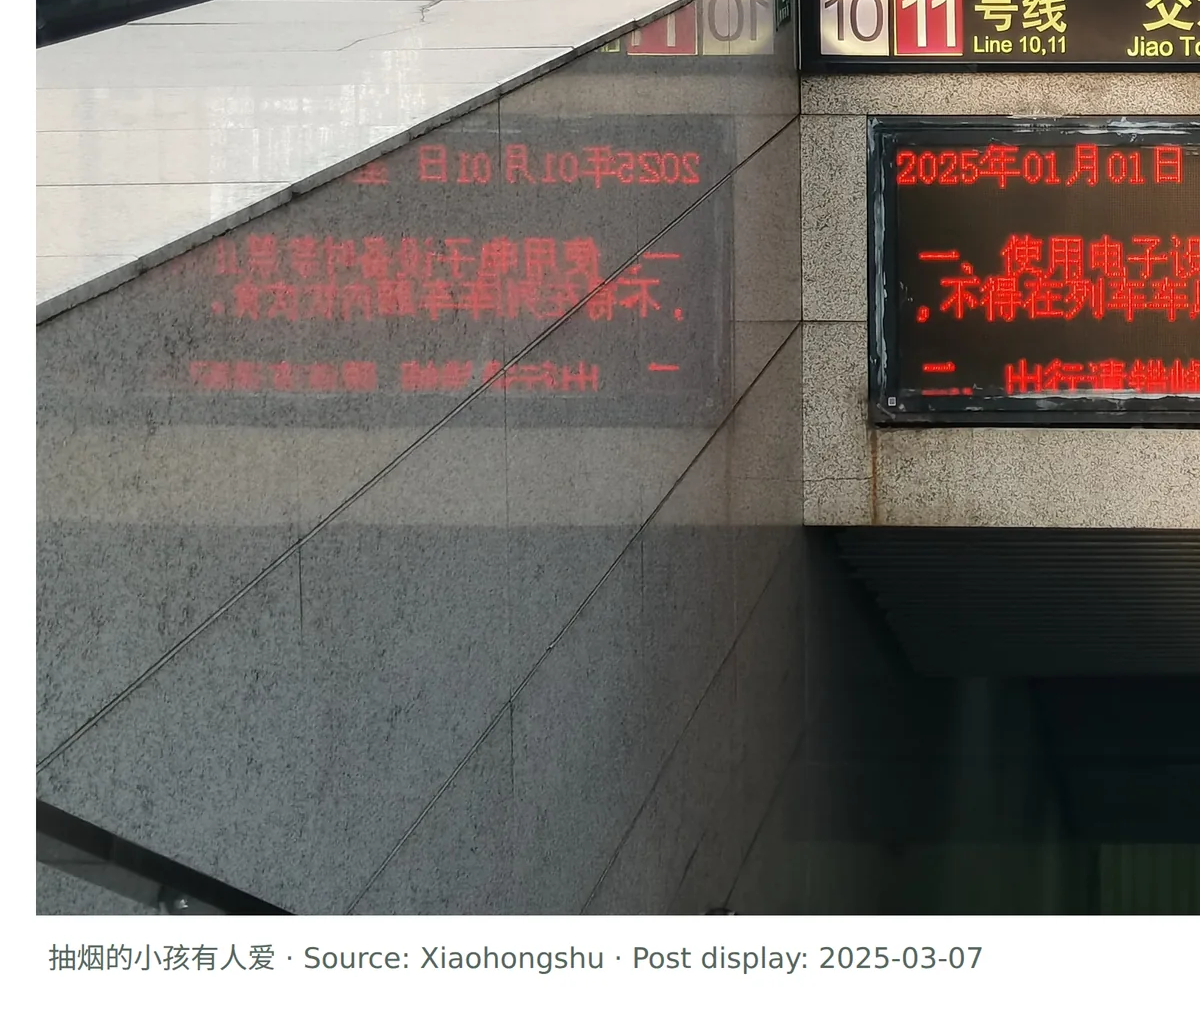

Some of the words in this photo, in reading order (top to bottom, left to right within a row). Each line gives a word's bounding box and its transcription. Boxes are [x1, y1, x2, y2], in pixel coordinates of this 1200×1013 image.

[973, 35, 1013, 54] Line
[1019, 35, 1067, 56] 10,11
[1126, 35, 1174, 57] Jiao
[896, 143, 1183, 188] 2025年01月01日
